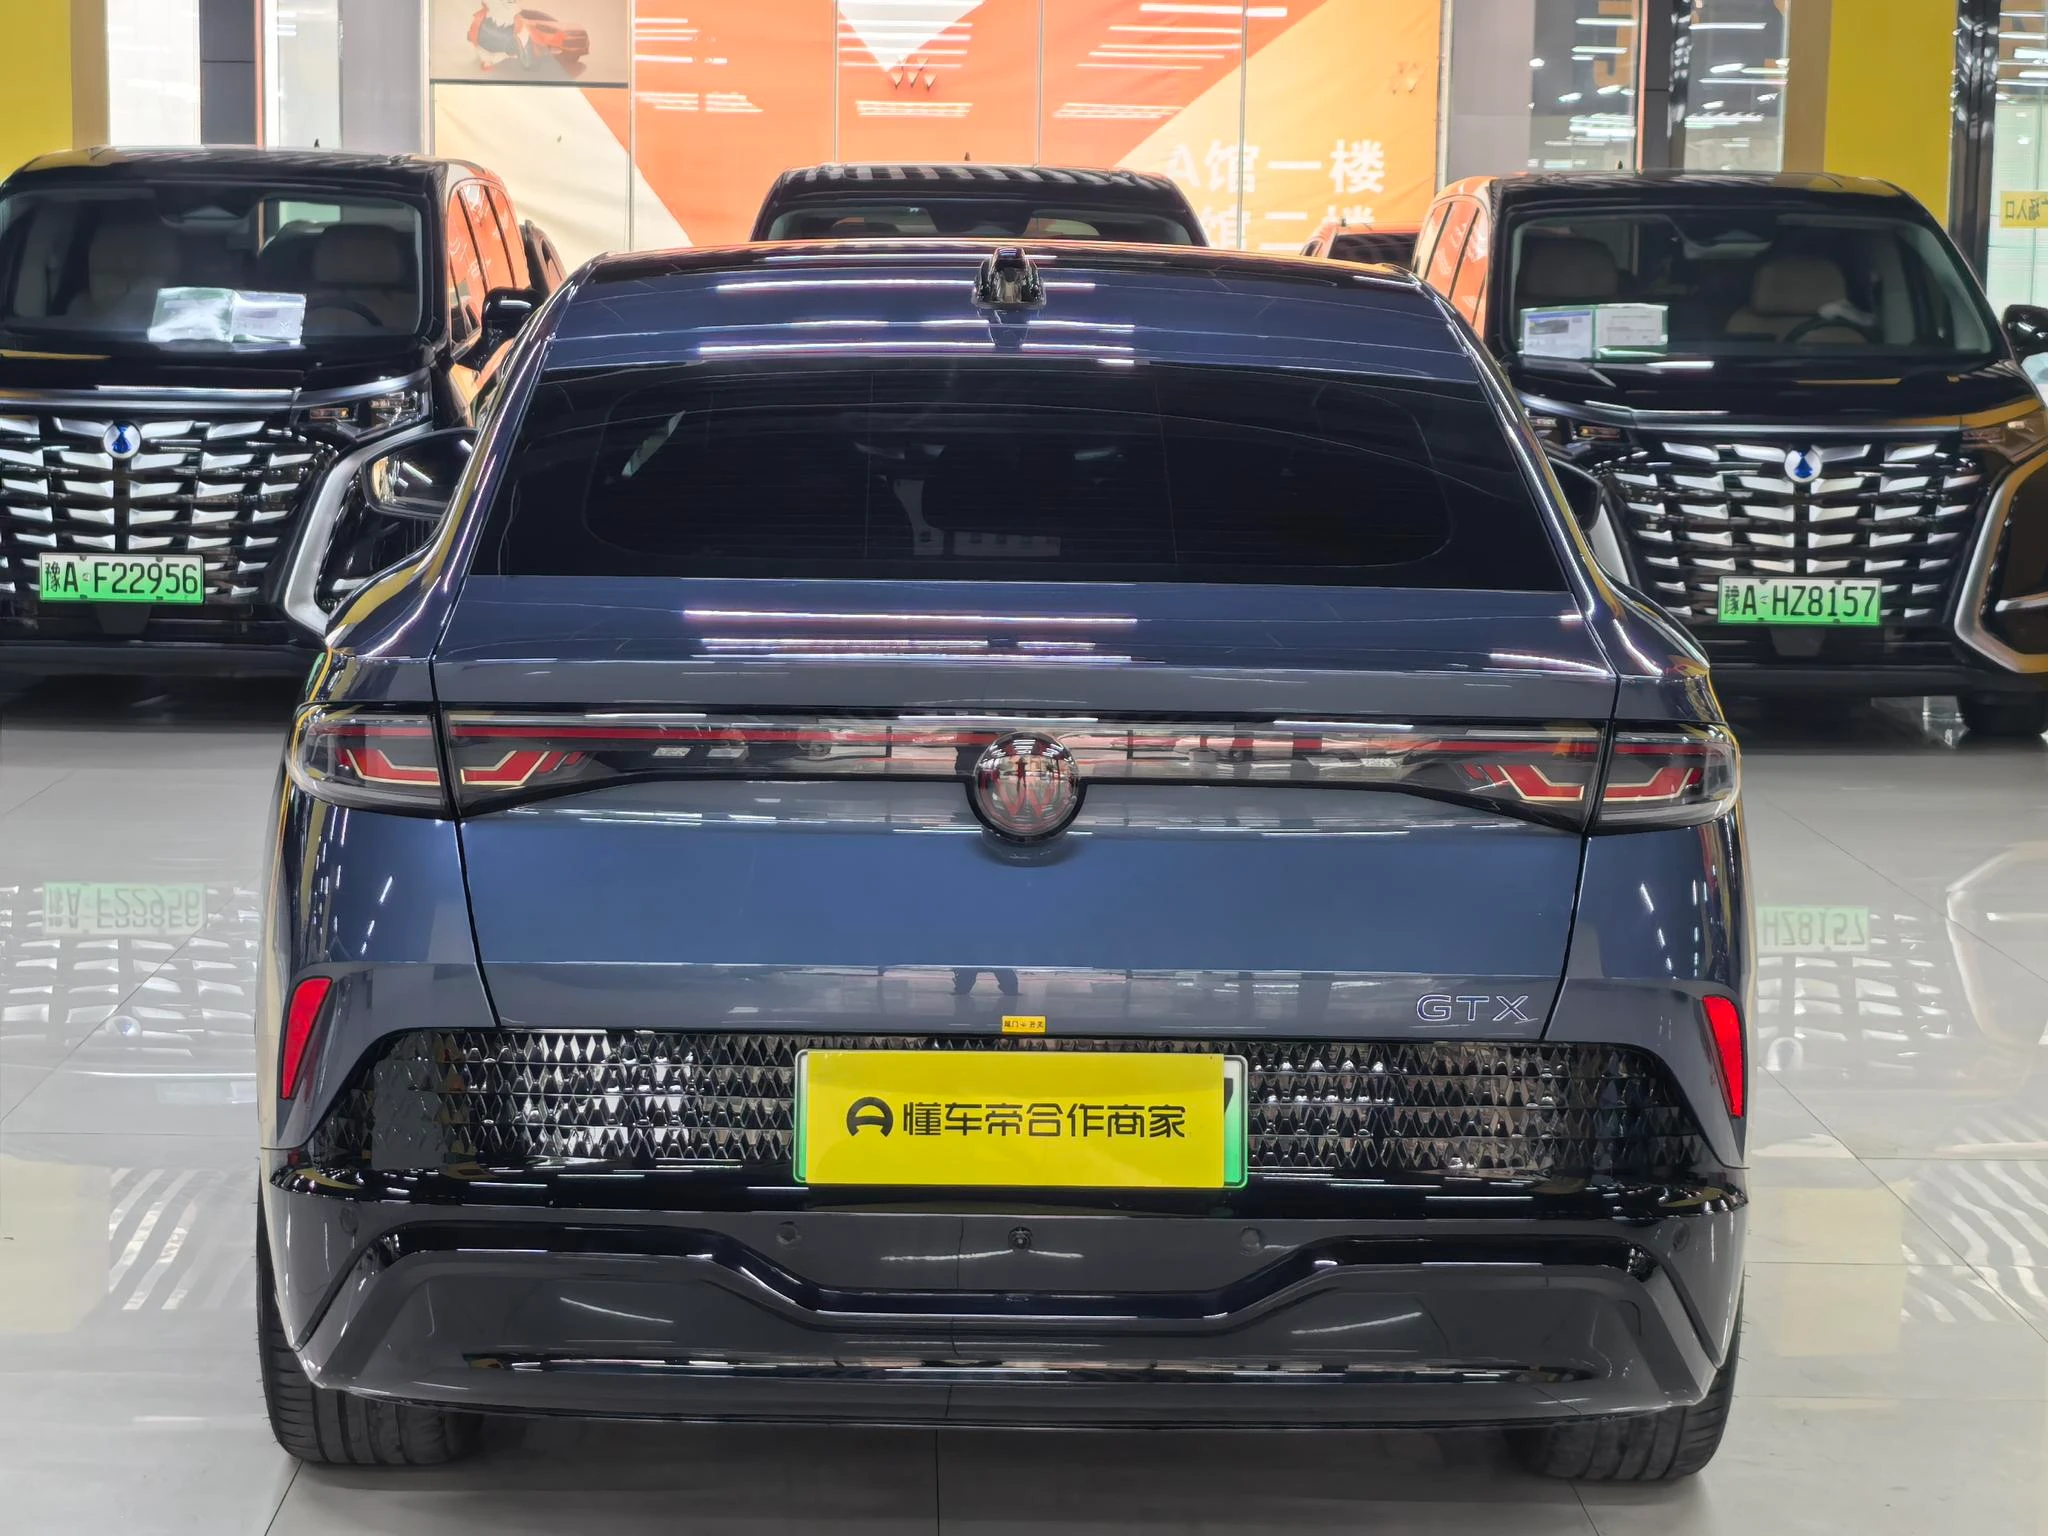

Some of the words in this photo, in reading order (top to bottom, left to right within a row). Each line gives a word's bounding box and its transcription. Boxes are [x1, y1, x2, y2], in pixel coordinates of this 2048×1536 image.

[1164, 138, 1385, 194] A馆一楼
[1200, 204, 1376, 251] 馆二
[1416, 994, 1530, 1022] GTX
[903, 1101, 1187, 1138] 懂车帝合作商家
